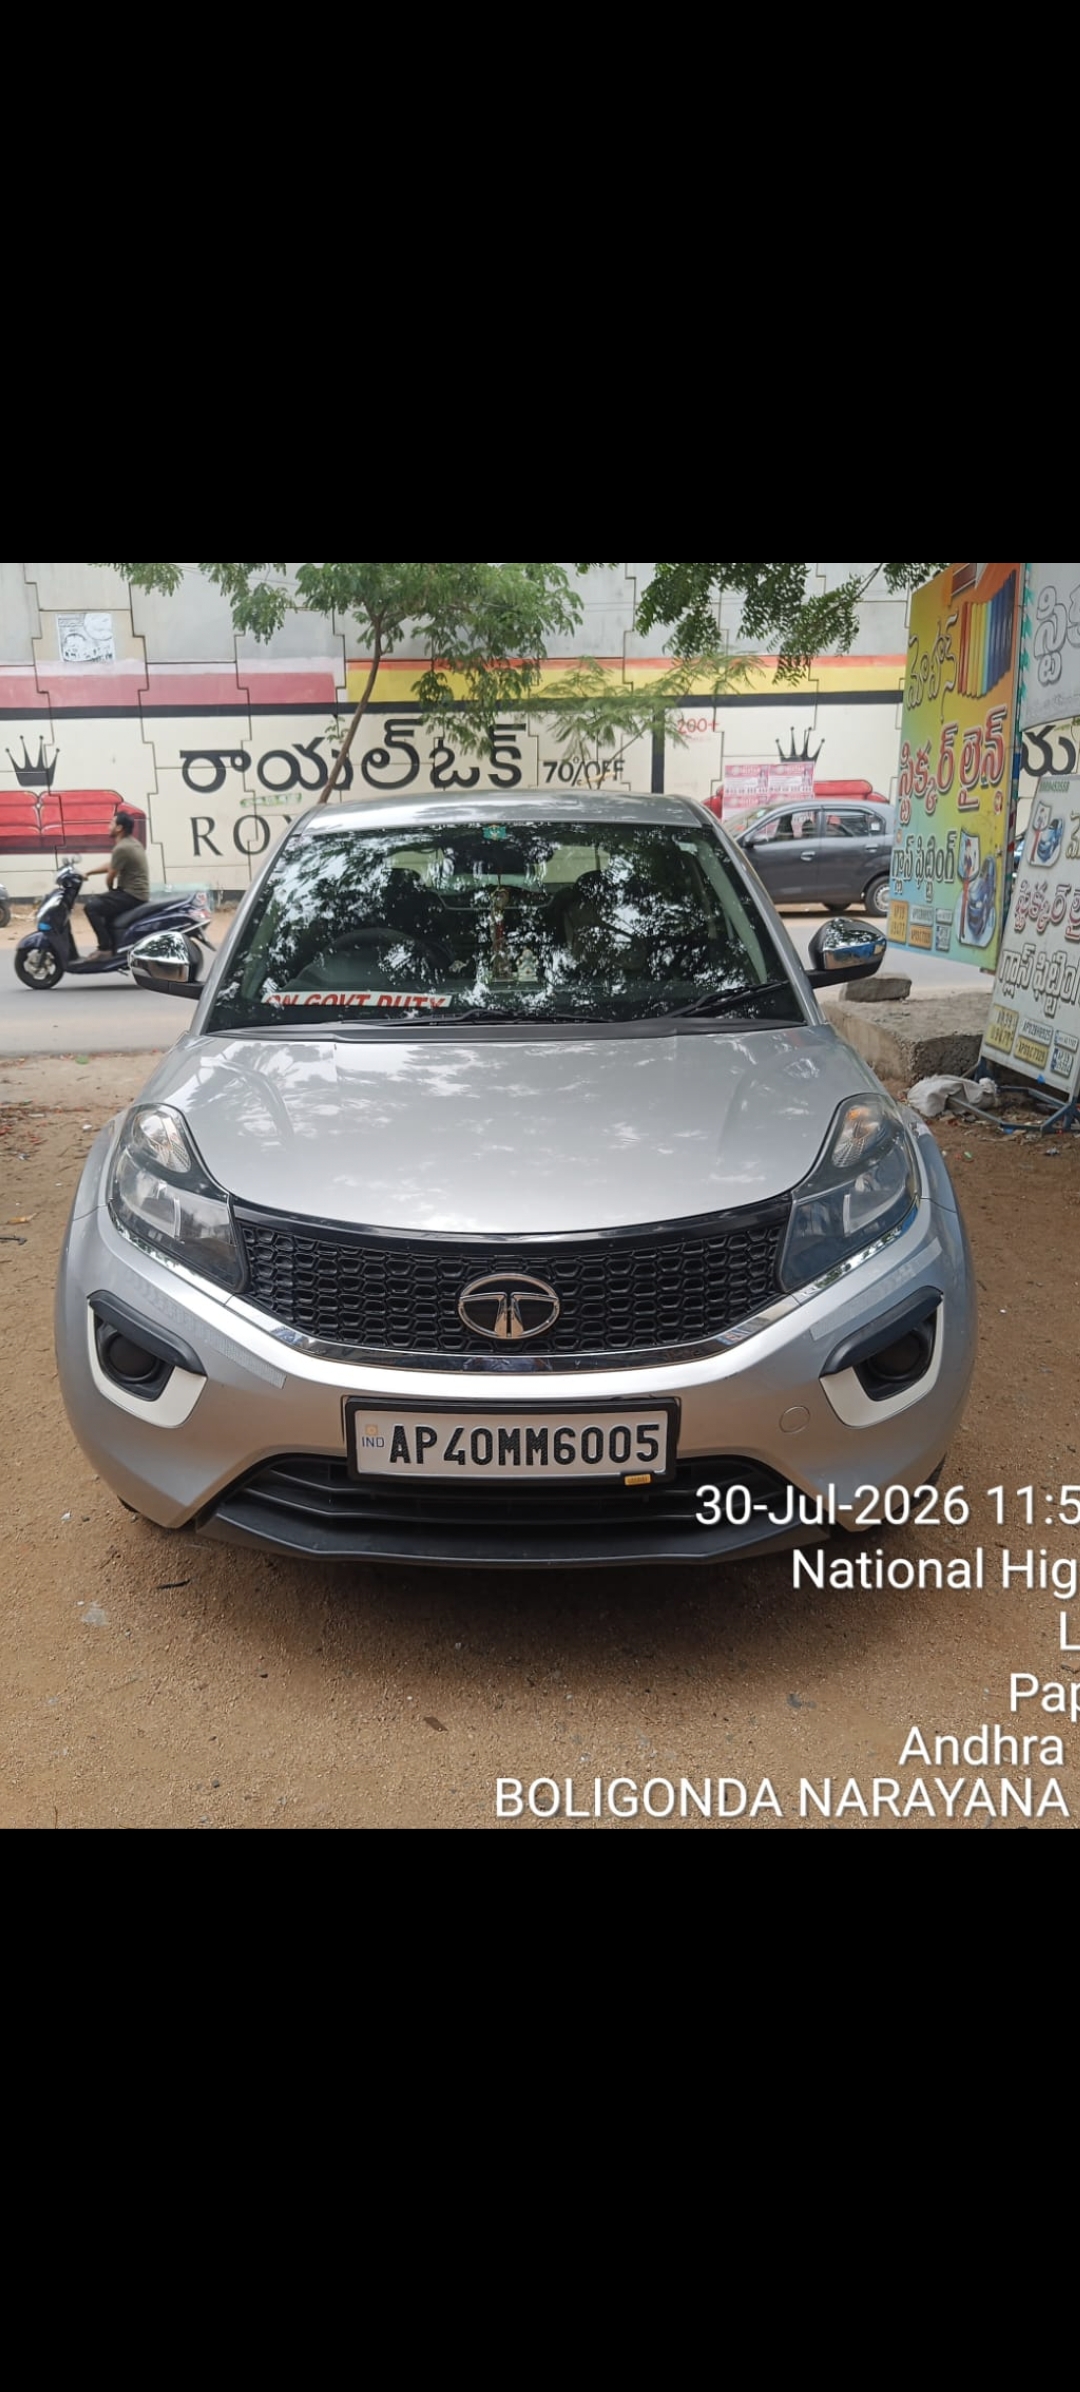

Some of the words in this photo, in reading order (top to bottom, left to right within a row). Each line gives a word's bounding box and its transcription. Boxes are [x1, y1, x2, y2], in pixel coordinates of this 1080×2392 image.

[190, 815, 293, 857] RO
[301, 994, 371, 1007] GOVT
[376, 995, 446, 1008] DUTY
[361, 1436, 385, 1449] IND
[389, 1424, 660, 1467] AP40MM6005
